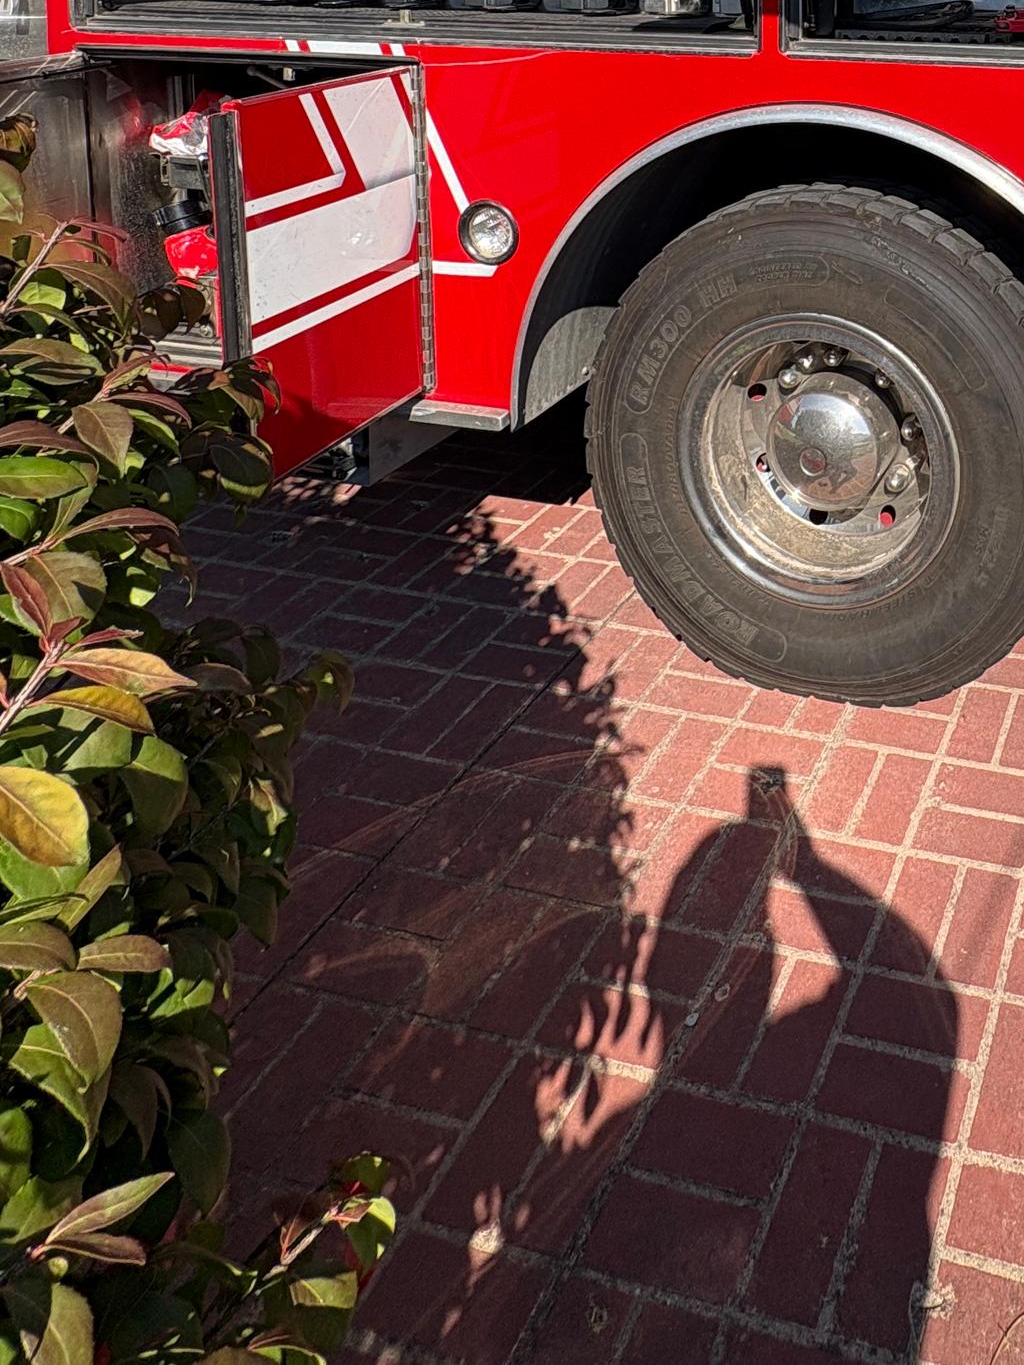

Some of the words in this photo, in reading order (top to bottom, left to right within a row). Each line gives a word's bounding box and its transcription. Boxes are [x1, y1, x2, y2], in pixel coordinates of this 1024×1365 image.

[630, 304, 692, 406] RM300
[699, 272, 738, 309] HH
[626, 465, 760, 645] ROADMASTER
